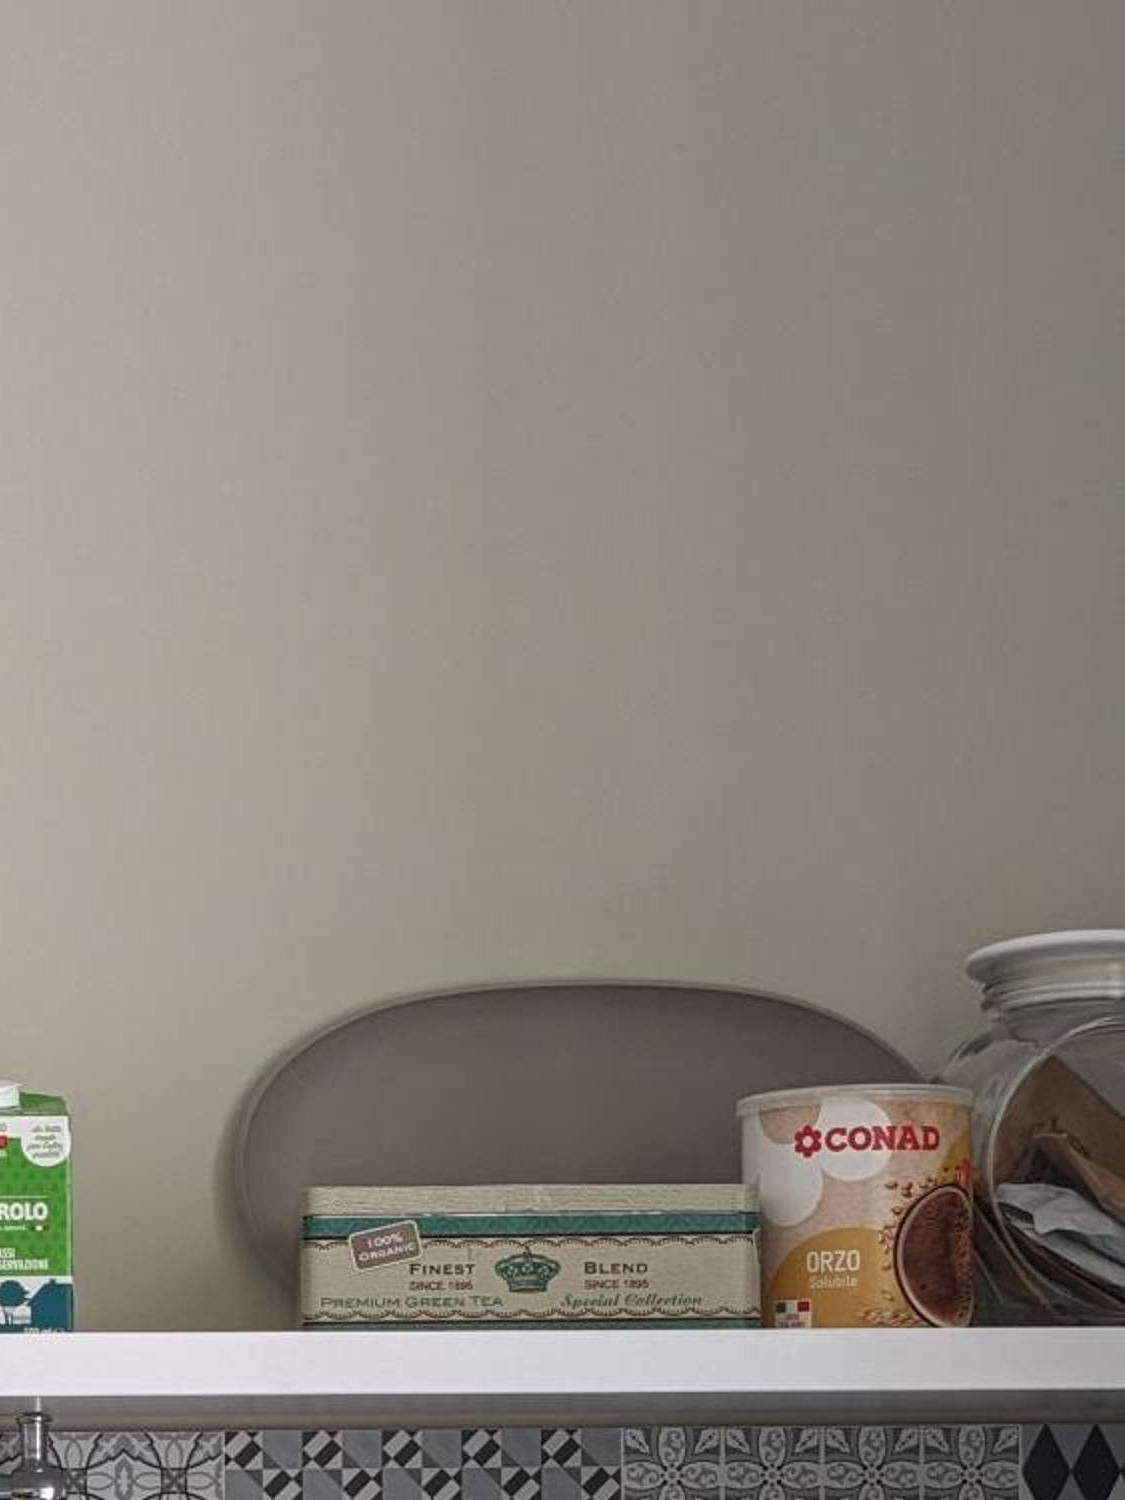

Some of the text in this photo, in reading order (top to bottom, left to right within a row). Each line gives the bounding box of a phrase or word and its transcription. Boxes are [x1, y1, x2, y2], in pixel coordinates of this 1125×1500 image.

[824, 1125, 940, 1152] CONAD
[357, 1243, 416, 1262] ORGANIC
[806, 1249, 860, 1273] ORZO
[409, 1261, 649, 1276] FINEST BLEND
[320, 1297, 400, 1309] PREMIUM
[472, 1295, 504, 1307] TEA
